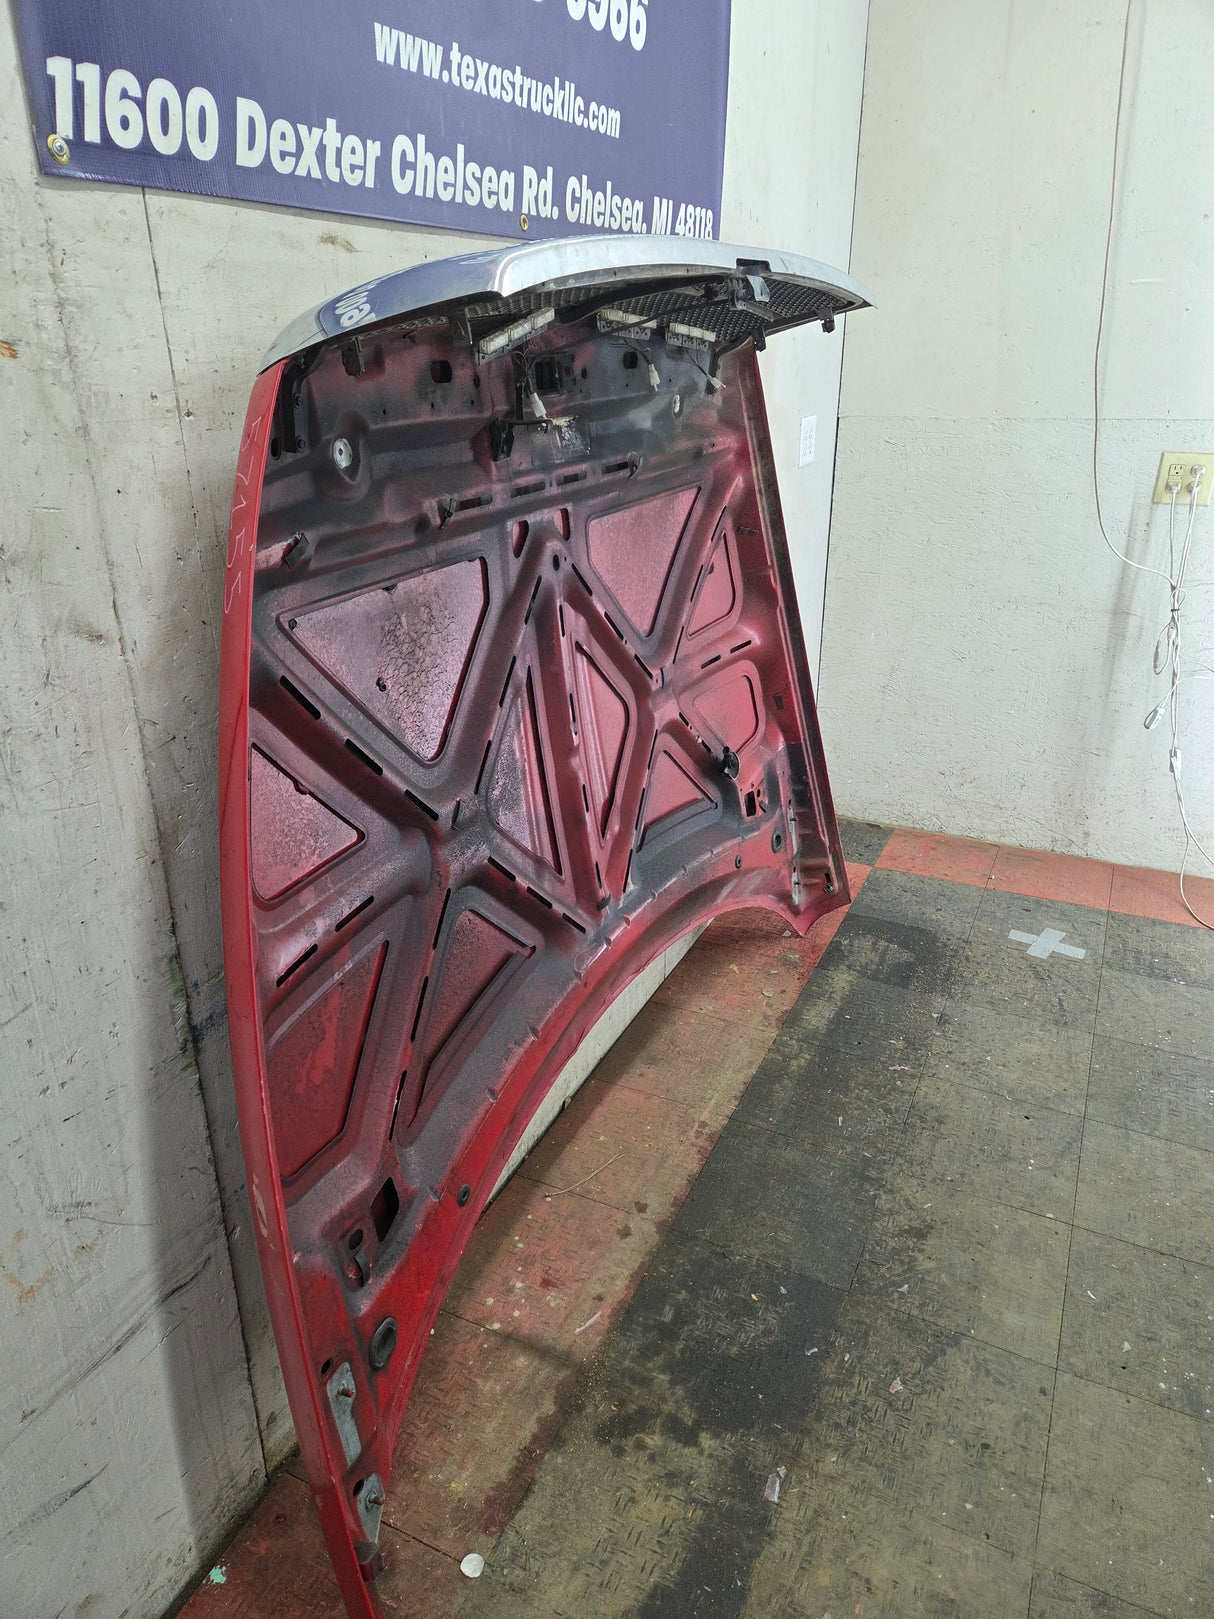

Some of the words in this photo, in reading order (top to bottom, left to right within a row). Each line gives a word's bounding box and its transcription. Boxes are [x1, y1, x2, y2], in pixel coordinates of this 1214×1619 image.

[374, 22, 621, 139] www.texastruckllc.com
[567, 0, 648, 51] 66
[46, 56, 219, 161] 11600
[236, 96, 381, 189] Dexter
[391, 133, 515, 212] Chelsea
[521, 165, 559, 220] Rd.
[651, 195, 673, 235] MI
[675, 202, 713, 241] 48118
